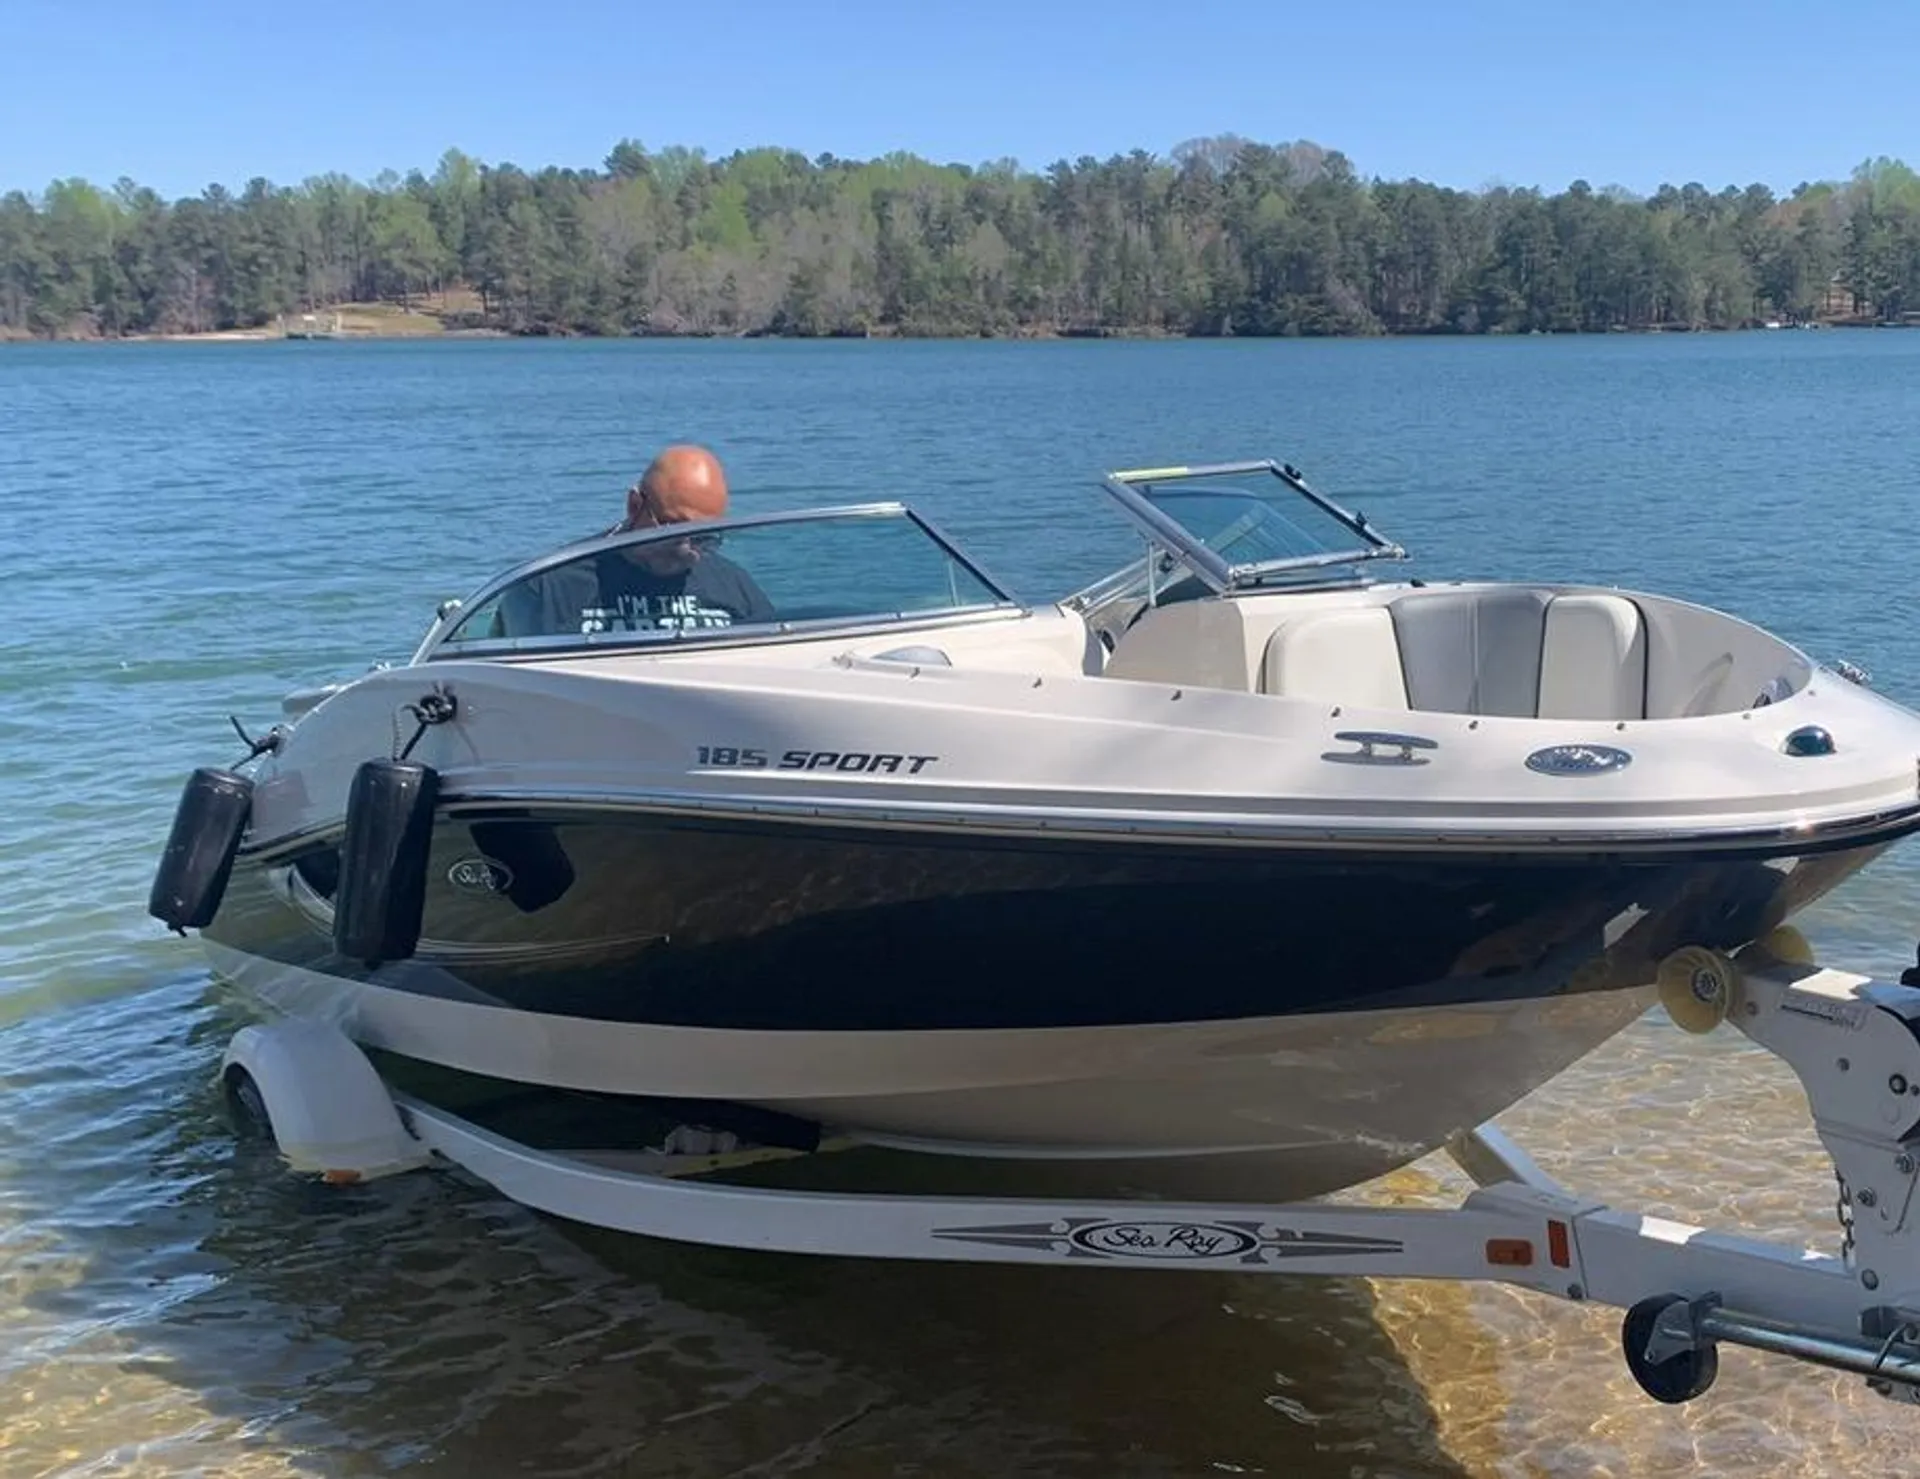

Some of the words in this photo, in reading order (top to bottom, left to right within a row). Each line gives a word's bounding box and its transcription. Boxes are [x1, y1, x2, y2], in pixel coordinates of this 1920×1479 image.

[617, 595, 648, 616] I'M
[656, 595, 697, 615] THE
[697, 746, 768, 767] 185
[778, 750, 940, 774] SPORT
[1103, 1227, 1159, 1248] Sea
[1164, 1226, 1224, 1255] Ray
